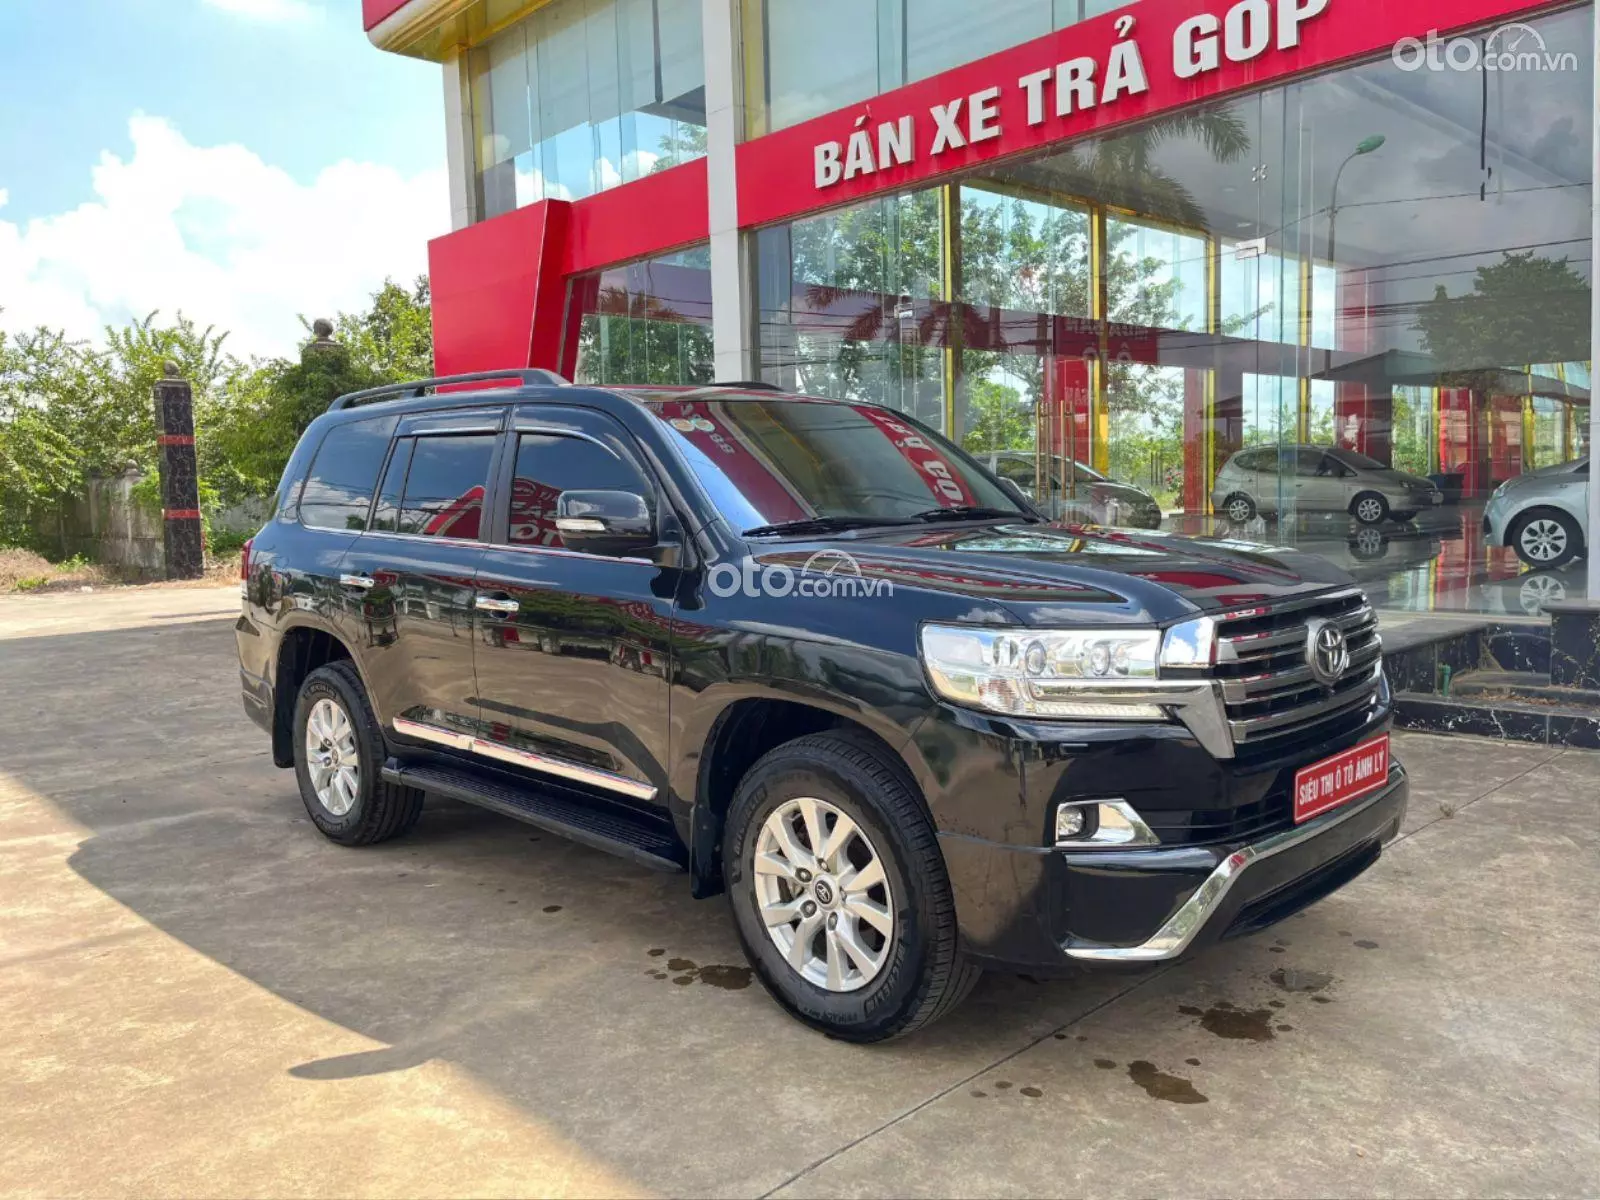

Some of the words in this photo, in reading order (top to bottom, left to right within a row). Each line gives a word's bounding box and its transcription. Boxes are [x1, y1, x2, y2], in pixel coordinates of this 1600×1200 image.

[813, 112, 915, 189] BÁN
[929, 86, 1002, 155] XE
[1018, 15, 1149, 127] TRẢ
[1299, 776, 1320, 806] SIÊU
[1320, 771, 1335, 797] THỊ
[1335, 764, 1342, 790] Ô
[1343, 760, 1354, 787] TÔ
[1374, 745, 1385, 773] LÝ
